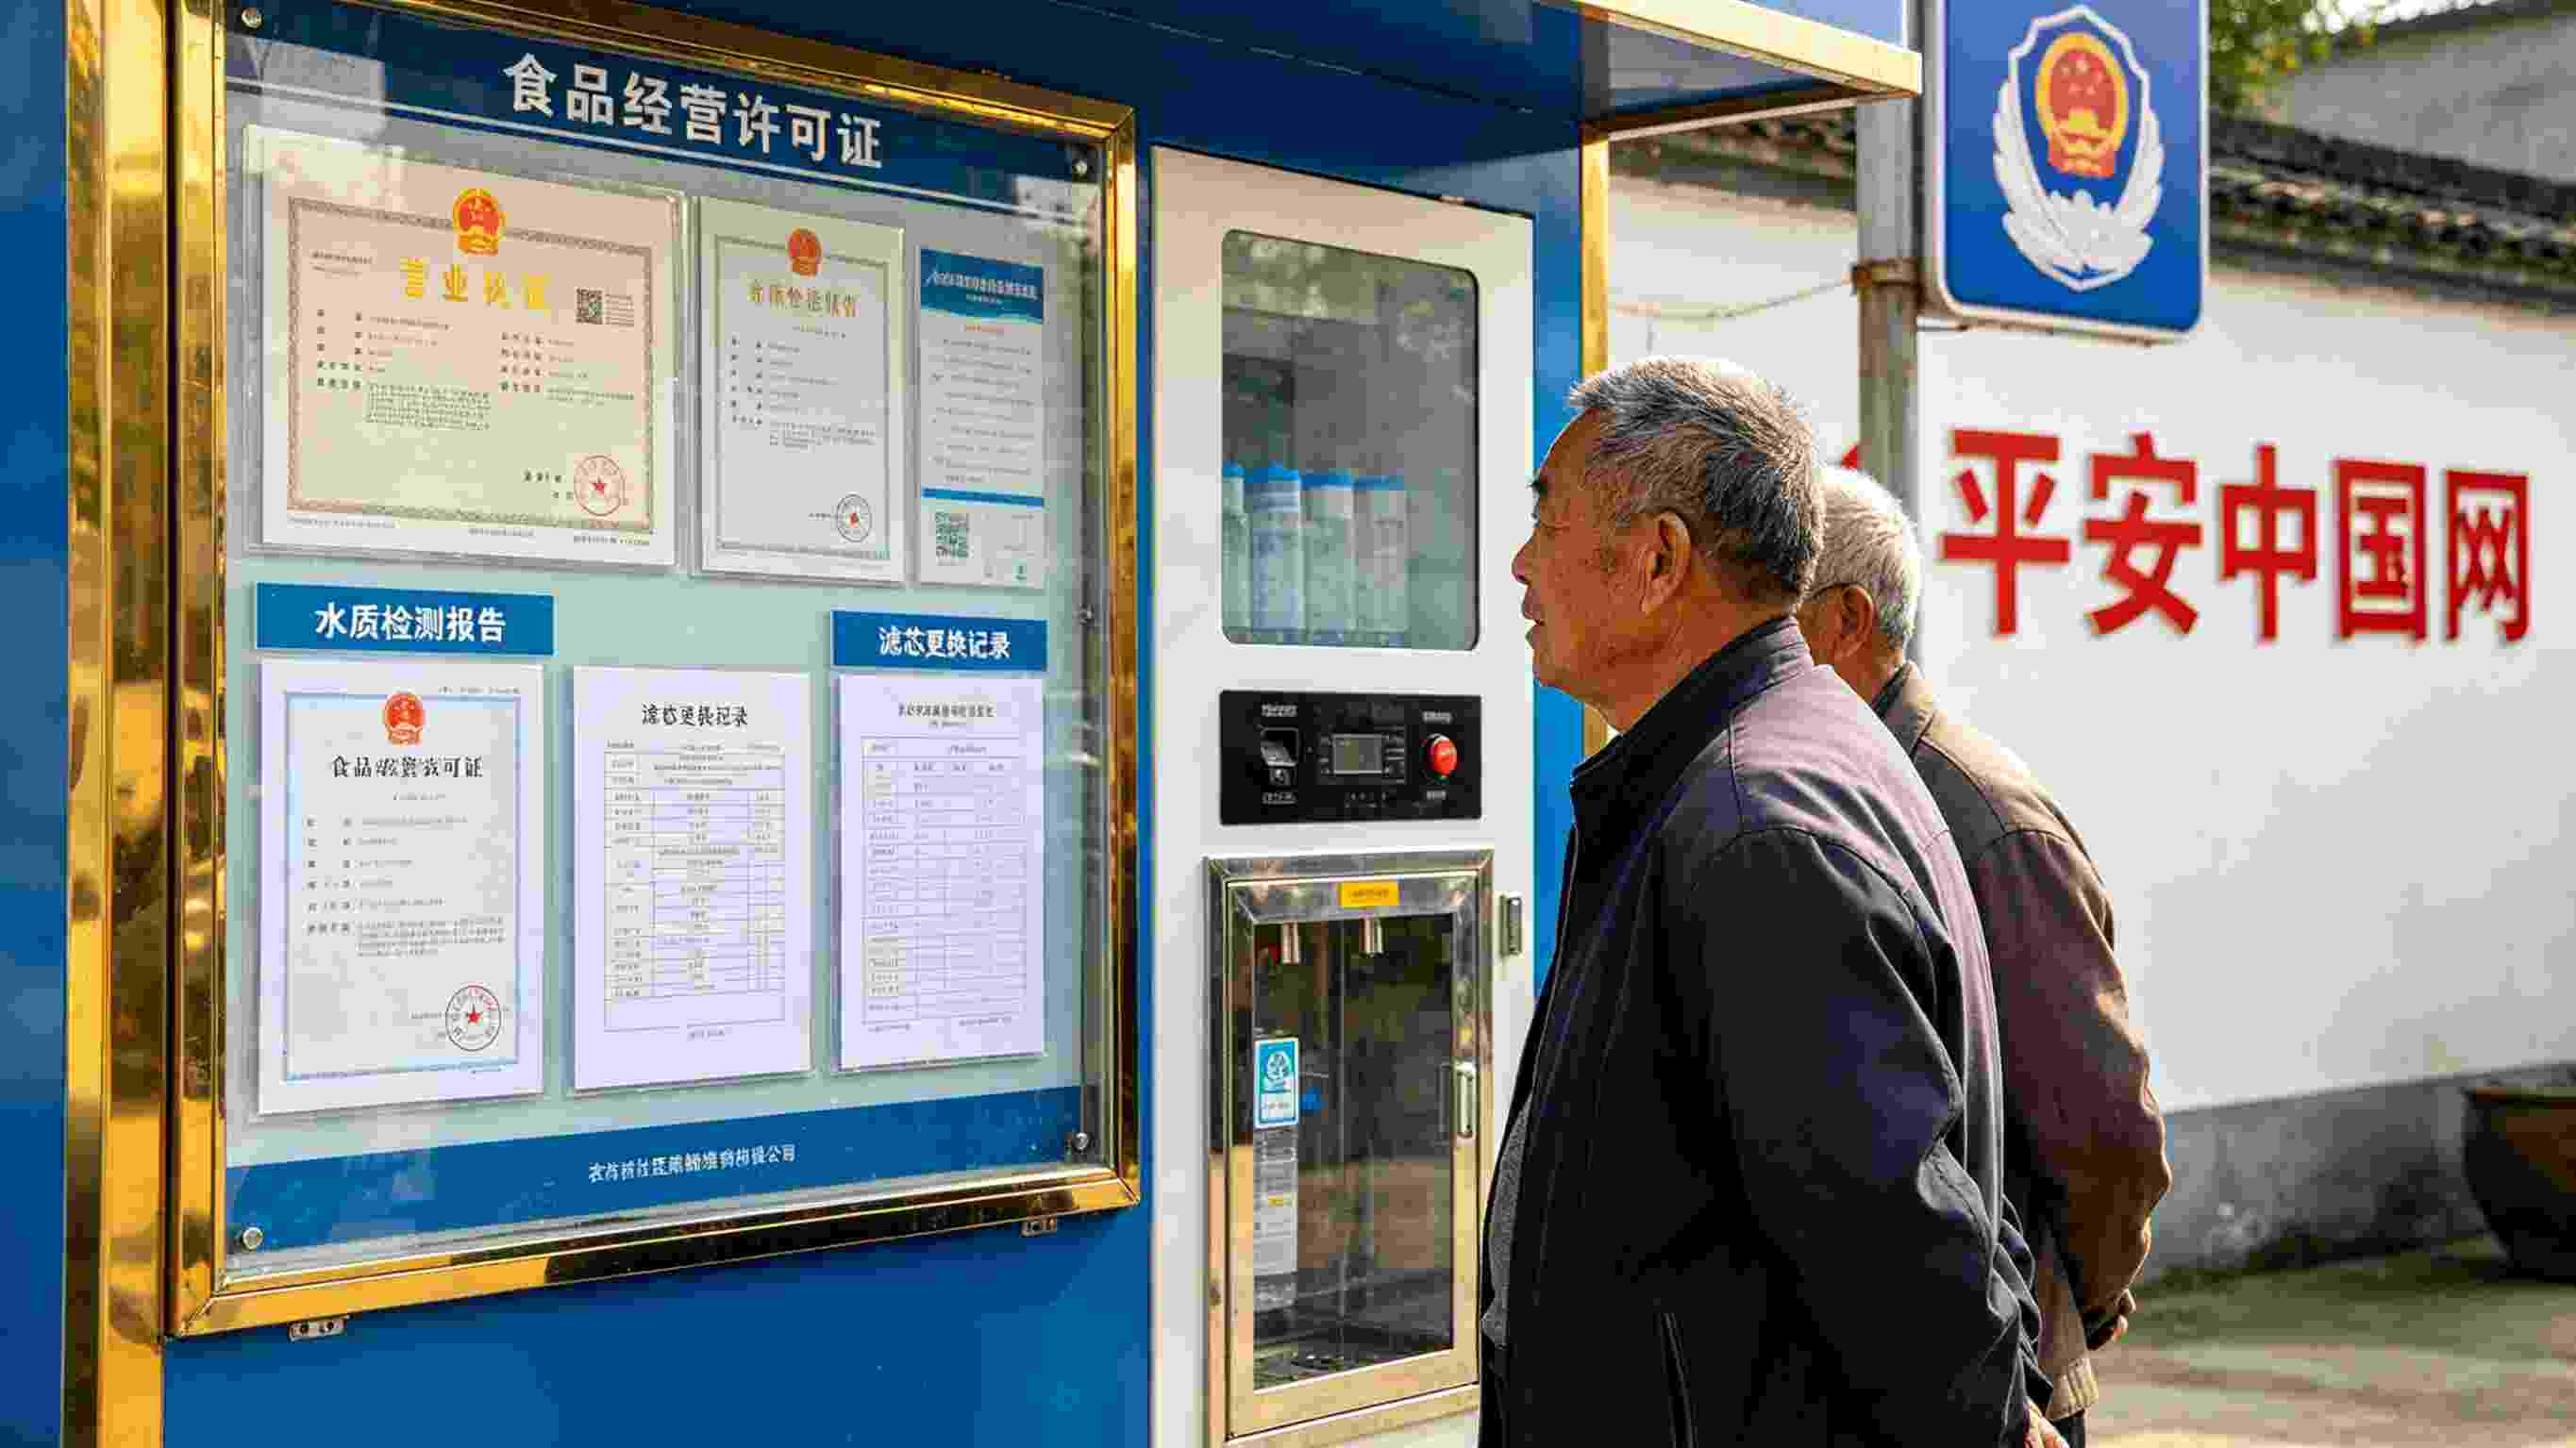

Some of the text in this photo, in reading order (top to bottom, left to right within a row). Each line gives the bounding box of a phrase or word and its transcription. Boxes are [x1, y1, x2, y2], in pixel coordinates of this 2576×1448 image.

[503, 53, 882, 169] 食品经营许可证
[1841, 427, 2531, 644] 平安中国网
[314, 601, 507, 642] 水质检测报告
[878, 625, 1012, 659] 滤芯更换记录
